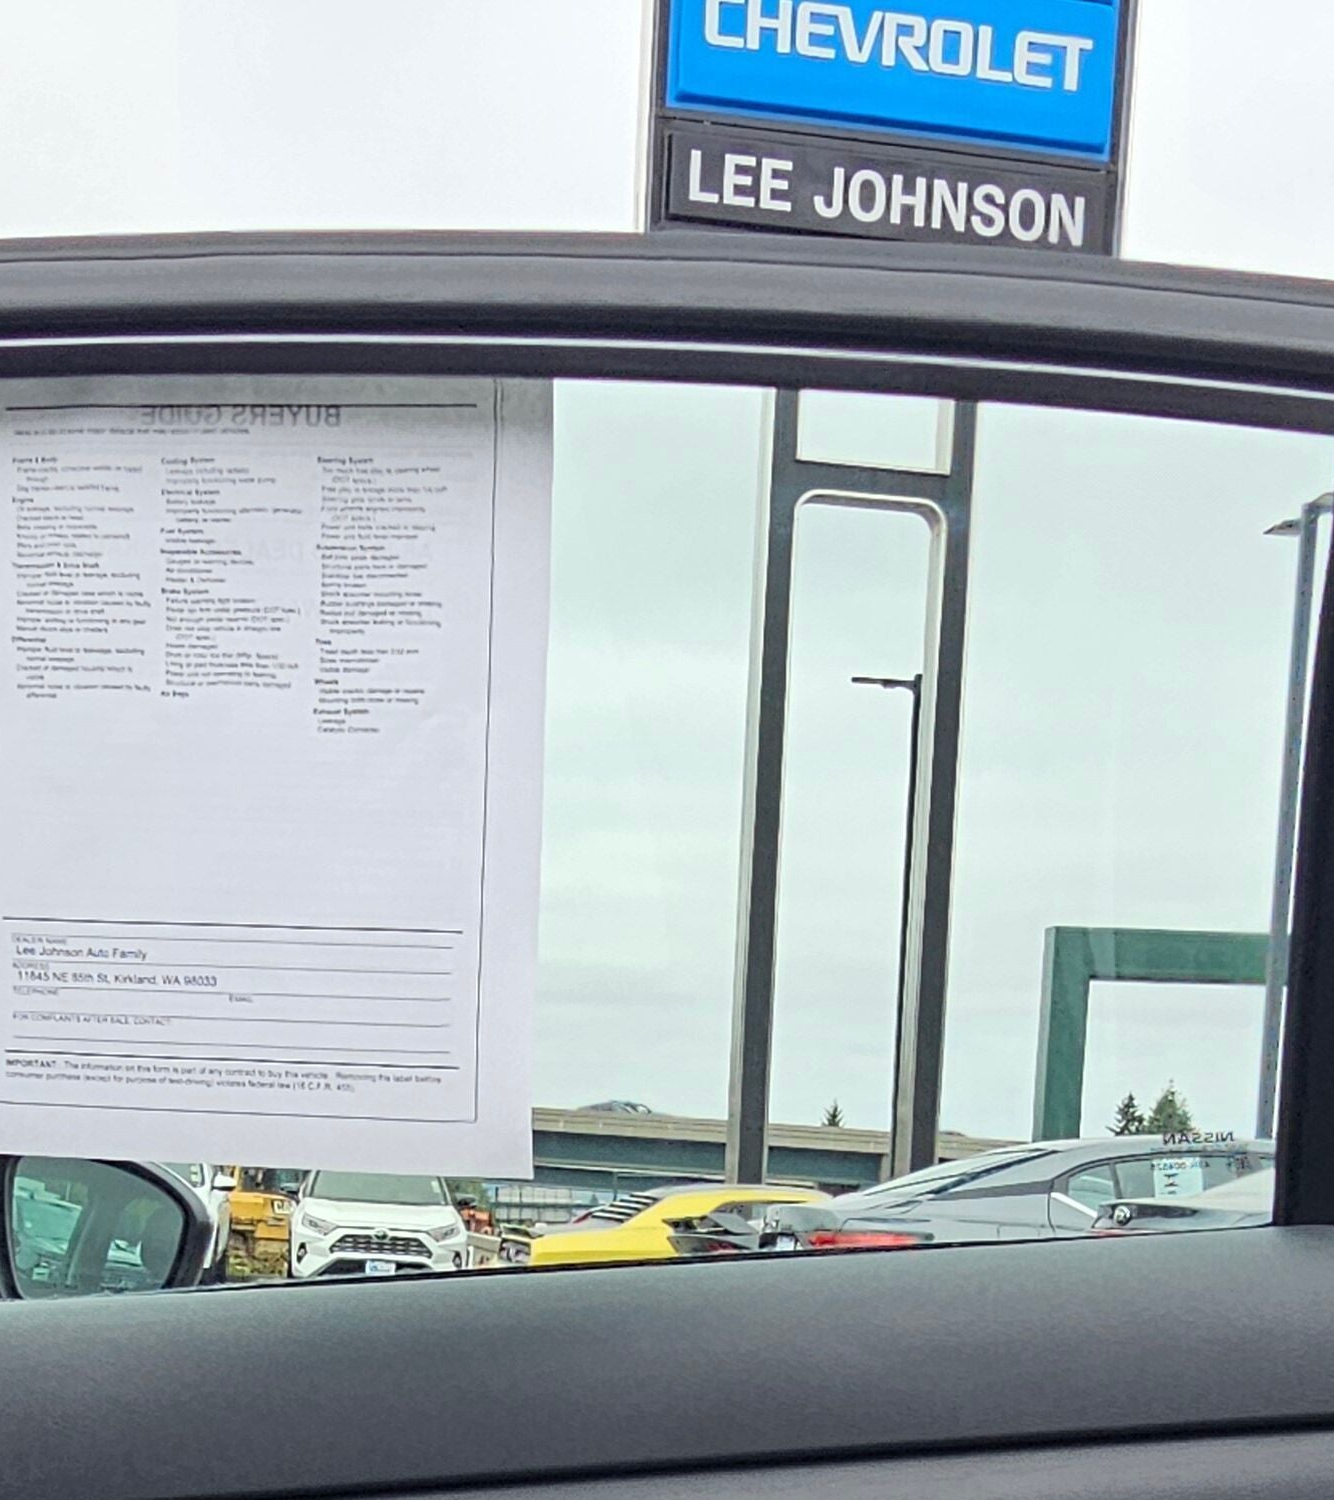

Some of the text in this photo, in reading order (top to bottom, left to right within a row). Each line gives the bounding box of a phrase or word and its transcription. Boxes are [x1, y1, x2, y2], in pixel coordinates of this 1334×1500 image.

[704, 0, 1094, 91] CHEVROLET
[689, 149, 1086, 247] LEE JOHNSON
[15, 945, 147, 961] Lee Johnson Auto Family
[52, 972, 68, 982] NE
[162, 975, 180, 986] WA
[183, 976, 218, 987] 98033
